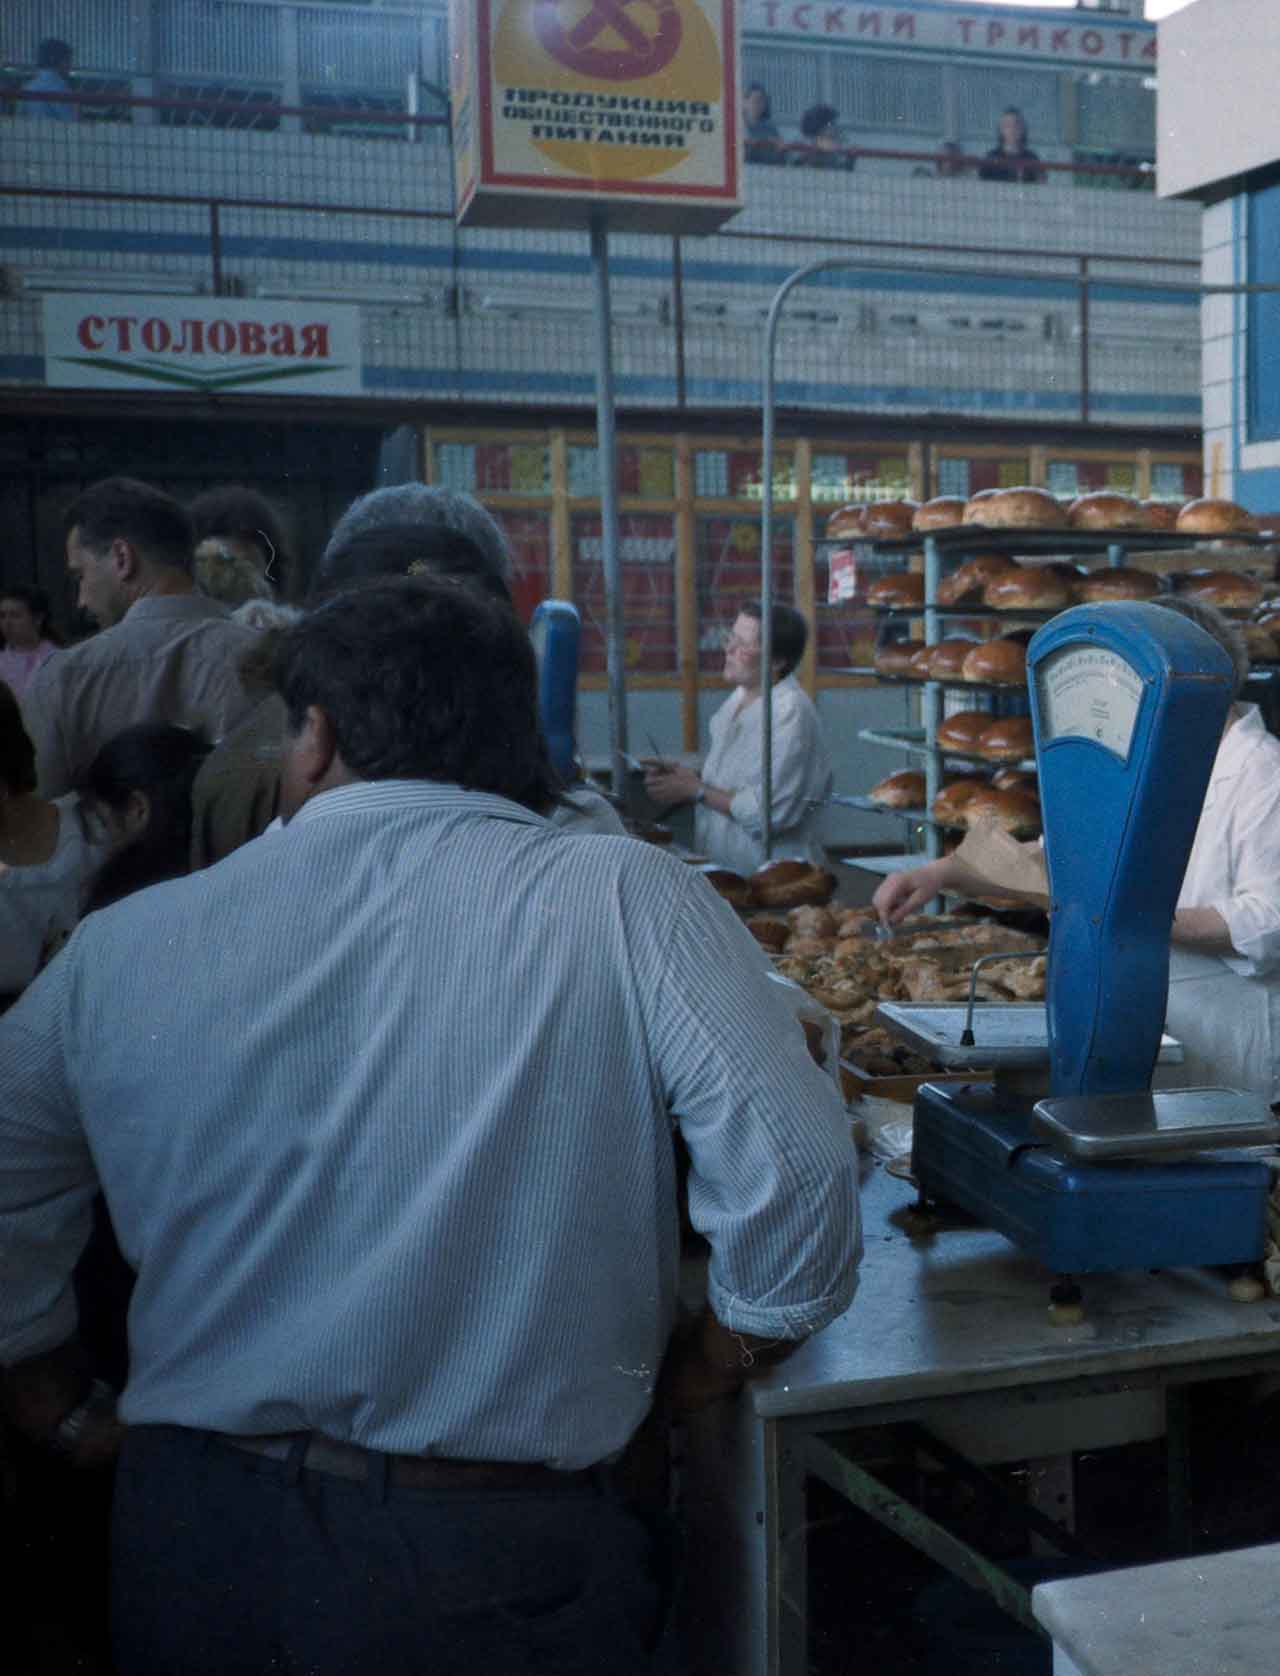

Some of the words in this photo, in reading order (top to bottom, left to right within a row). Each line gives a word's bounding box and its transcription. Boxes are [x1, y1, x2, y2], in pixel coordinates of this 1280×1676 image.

[503, 87, 710, 115] ПРОДУКЦИЯ
[503, 105, 715, 132] ОБЩЕСТВЕННОГО
[532, 125, 685, 147] ПИТАНИЯ
